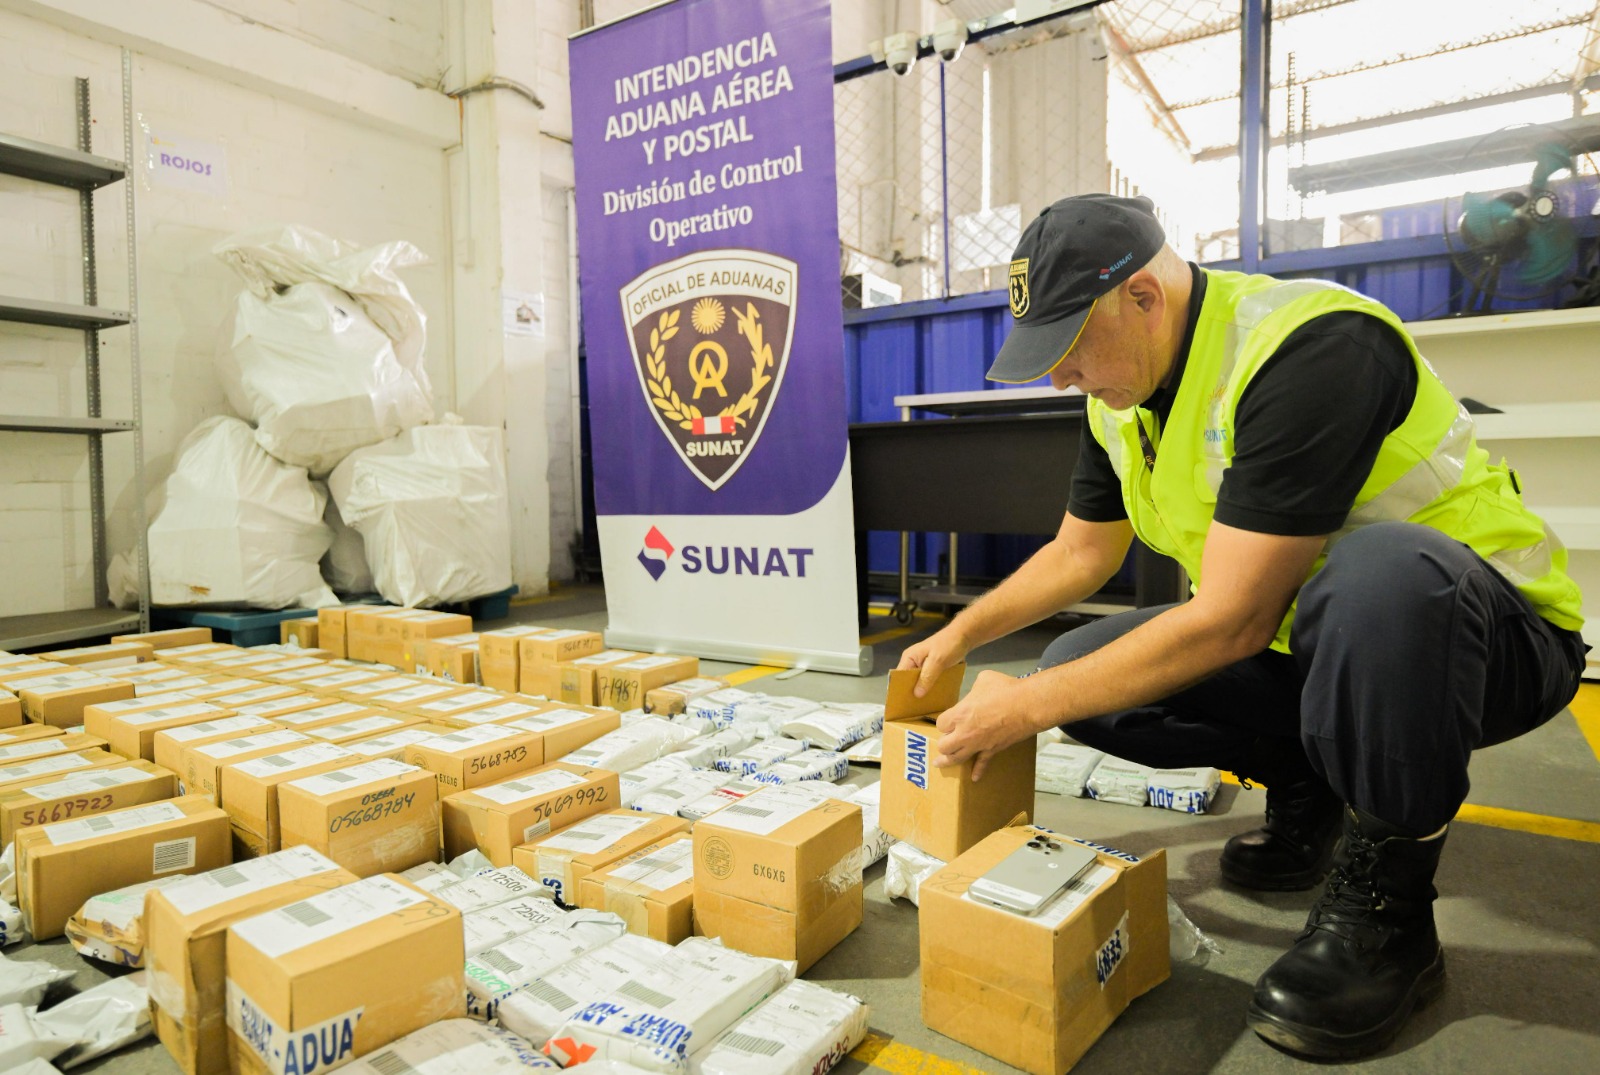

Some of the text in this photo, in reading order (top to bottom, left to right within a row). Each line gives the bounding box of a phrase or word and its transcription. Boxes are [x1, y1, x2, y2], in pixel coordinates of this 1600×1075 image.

[614, 32, 778, 105] INTENDENCIA
[604, 65, 795, 143] ADUANA AÉREA
[641, 115, 755, 166] Y POSTAL
[160, 152, 212, 176] ROJOS
[602, 145, 804, 216] División de Control
[649, 203, 754, 248] Operativo
[1109, 251, 1134, 273] SUNAT
[633, 271, 787, 317] OFICIAL DE ADUANAS
[686, 440, 745, 458] SUNAT
[681, 545, 814, 579] SUNAT
[20, 794, 115, 827] 5668723
[533, 785, 609, 825] 5669992
[753, 863, 786, 883] 6X6X6
